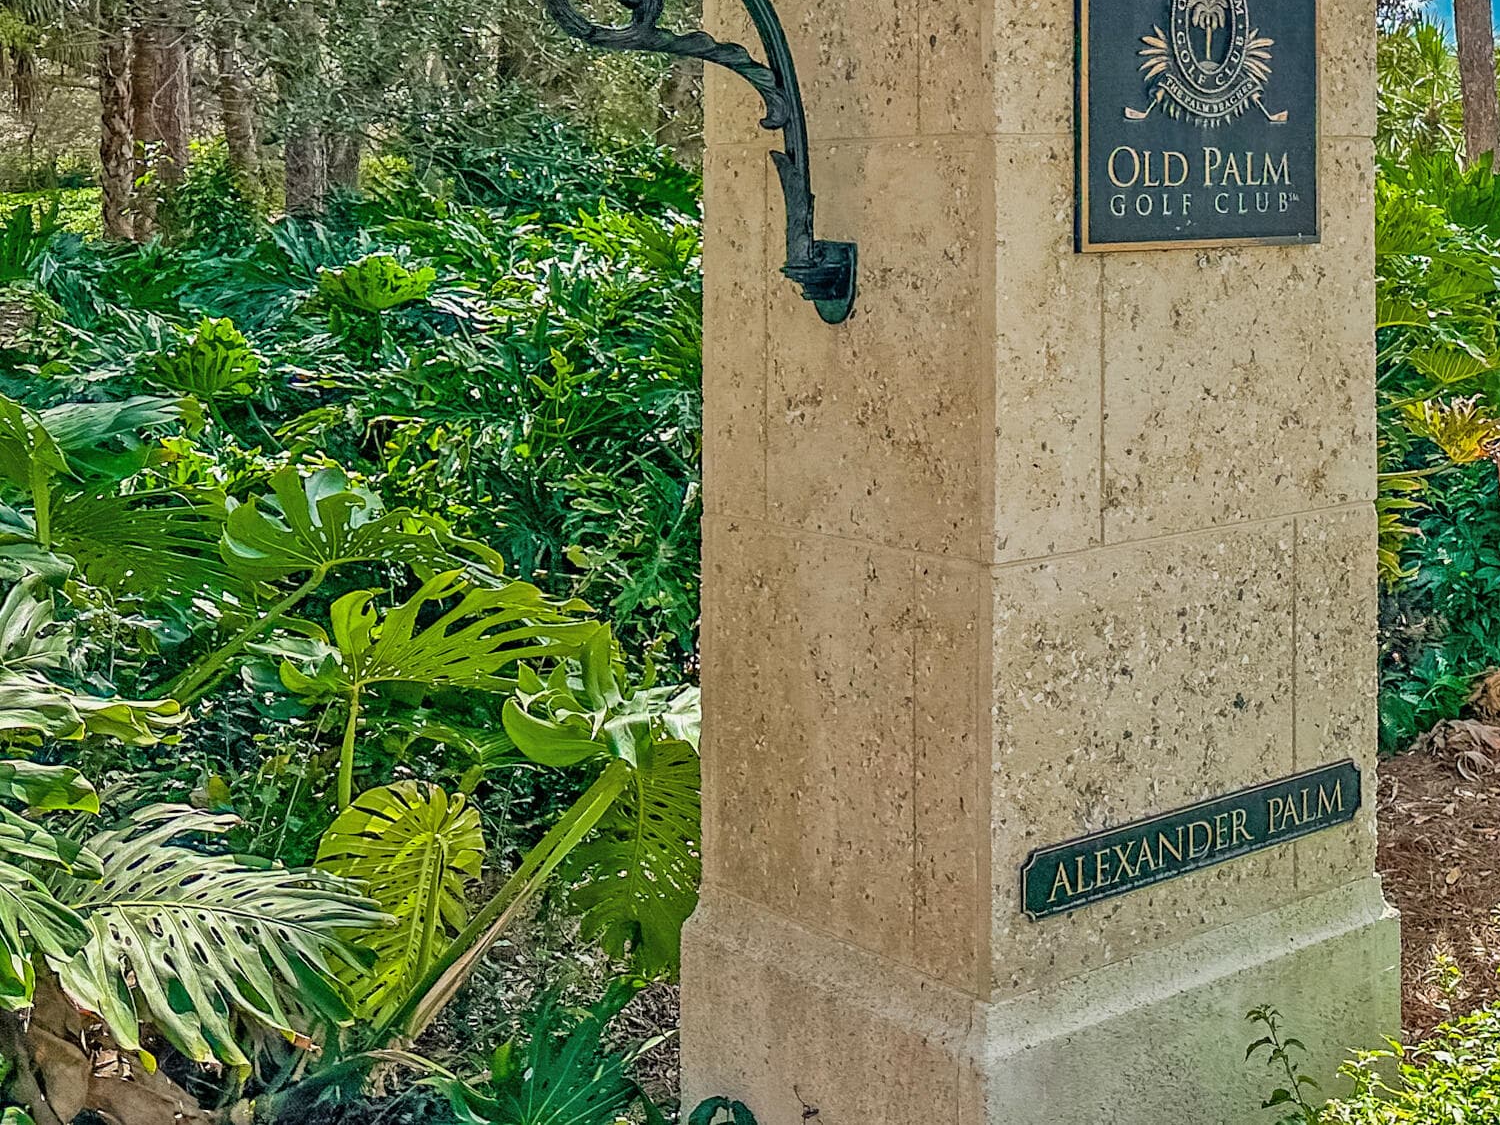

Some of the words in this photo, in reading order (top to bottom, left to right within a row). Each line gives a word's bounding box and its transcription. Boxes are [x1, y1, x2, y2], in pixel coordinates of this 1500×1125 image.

[1176, 31, 1207, 85] GOLF
[1215, 35, 1244, 86] CLUB
[1107, 145, 1189, 188] OLD
[1202, 146, 1292, 187] PALM
[1109, 193, 1192, 217] GOLF
[1214, 192, 1288, 214] CLUB
[1046, 807, 1254, 904] ALEXANDER
[1266, 778, 1345, 835] PALM
